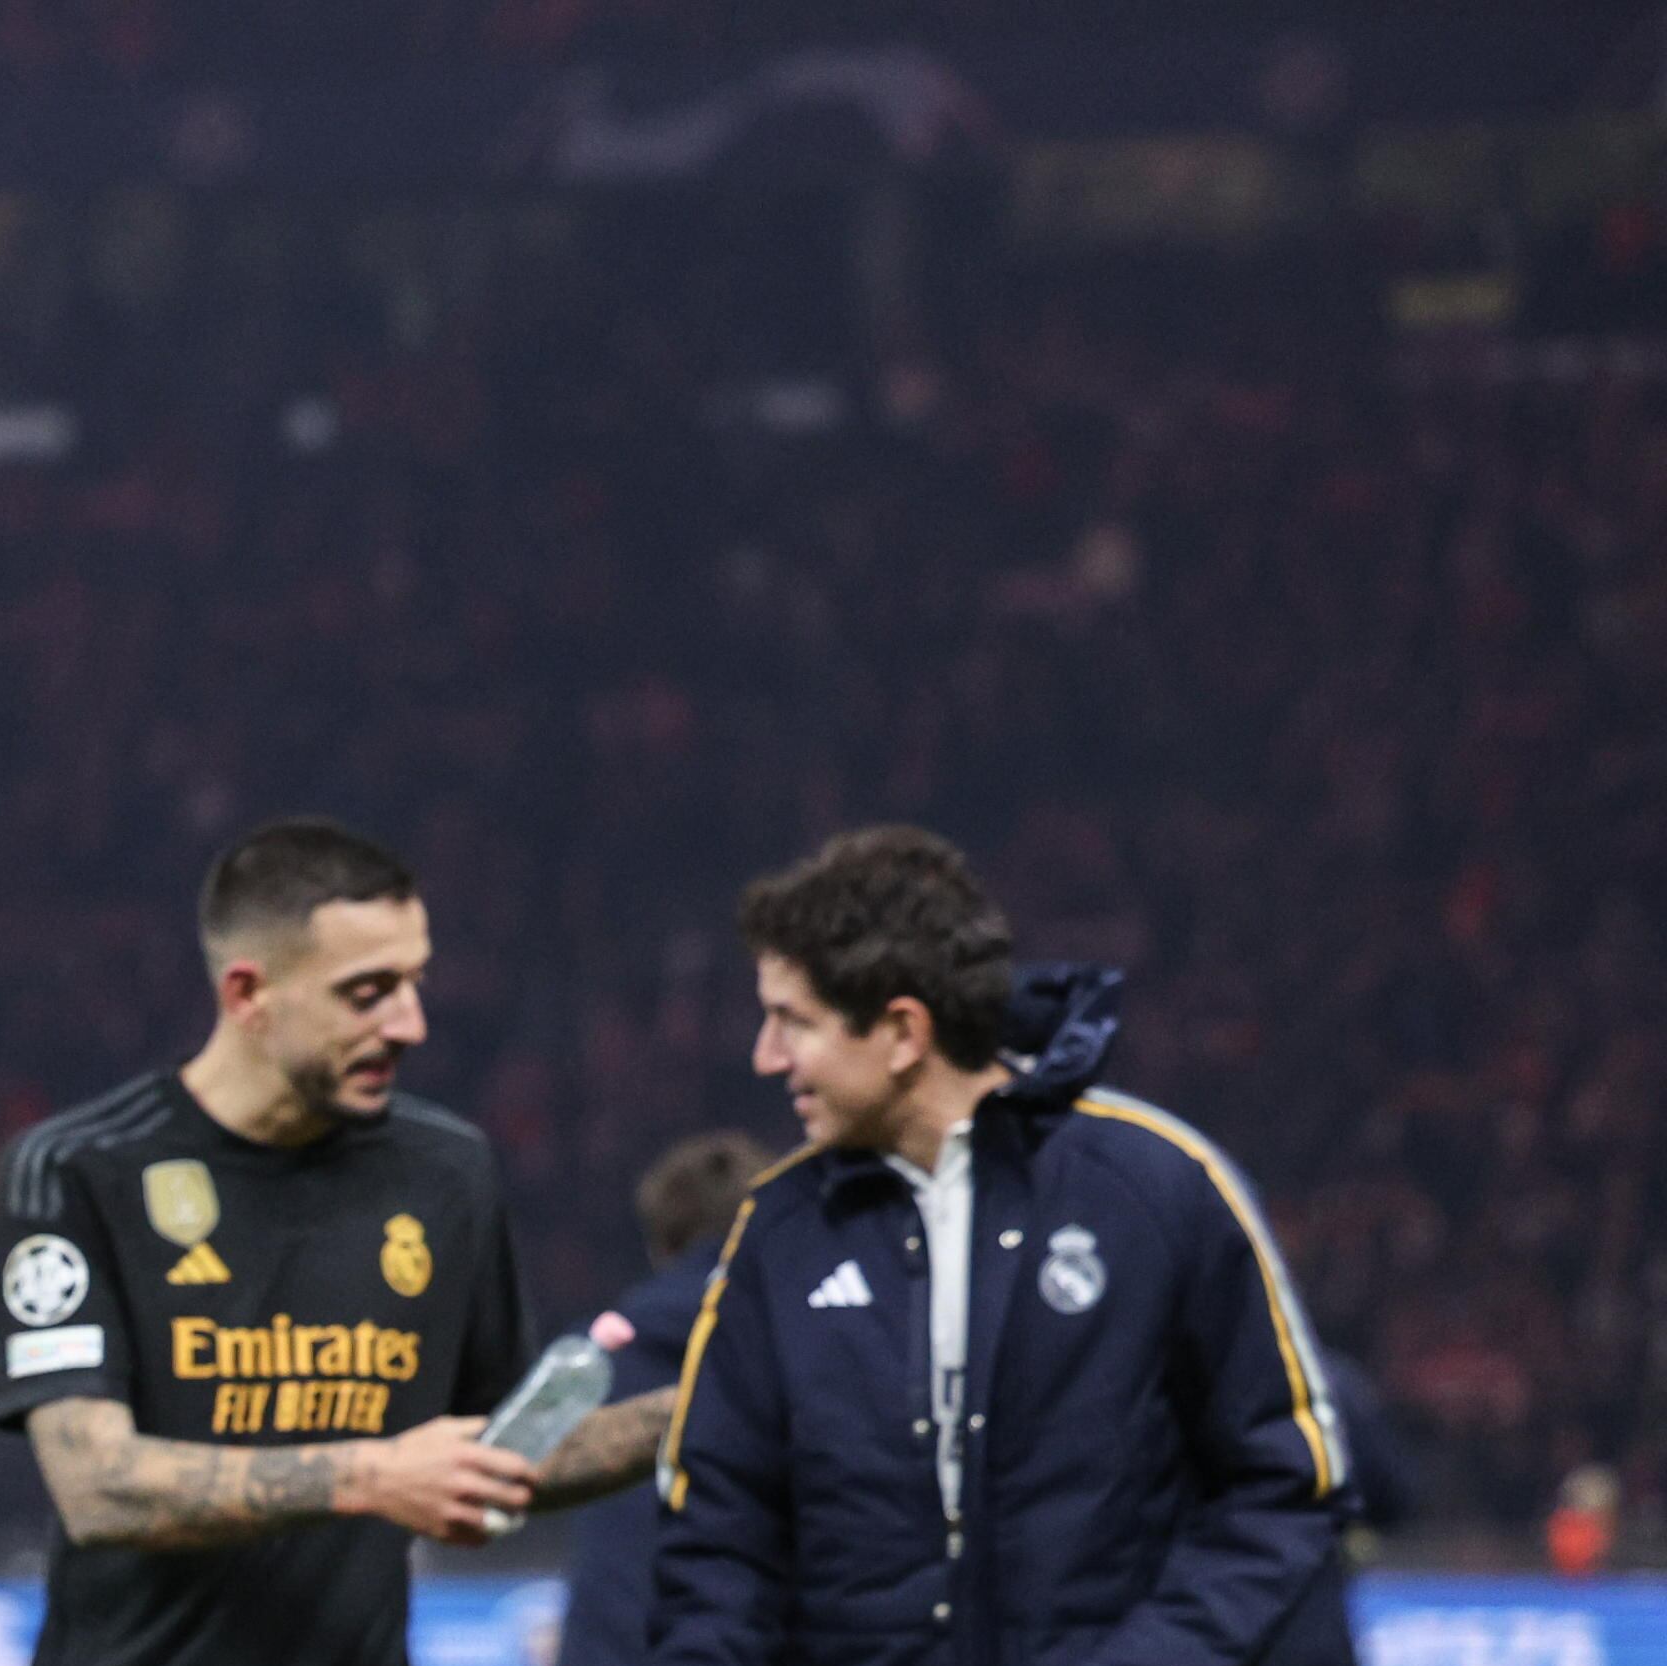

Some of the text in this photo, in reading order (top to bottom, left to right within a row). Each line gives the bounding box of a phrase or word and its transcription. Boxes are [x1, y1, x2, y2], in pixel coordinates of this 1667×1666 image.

[171, 1313, 421, 1381] Emirates
[212, 1380, 391, 1434] FLY BETTER
